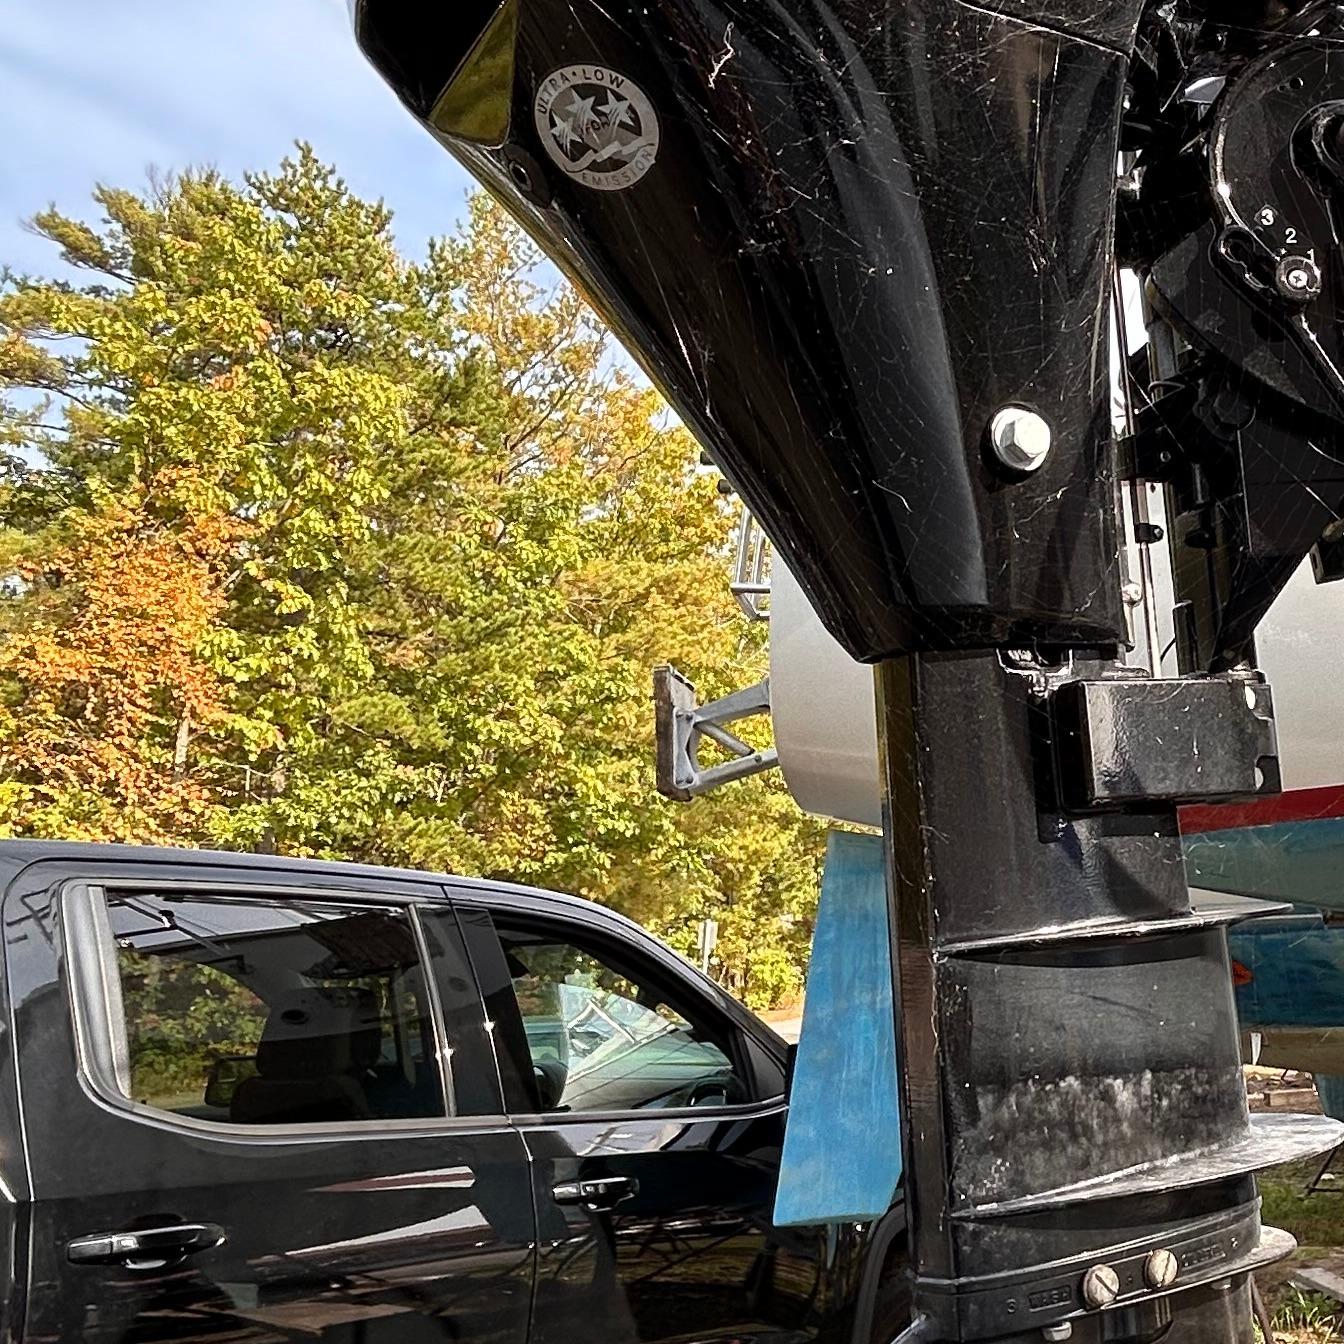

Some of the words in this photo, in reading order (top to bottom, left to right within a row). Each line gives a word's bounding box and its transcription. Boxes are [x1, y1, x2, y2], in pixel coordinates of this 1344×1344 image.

[582, 68, 625, 90] LOW
[1260, 208, 1274, 226] 3
[1285, 227, 1298, 244] 2
